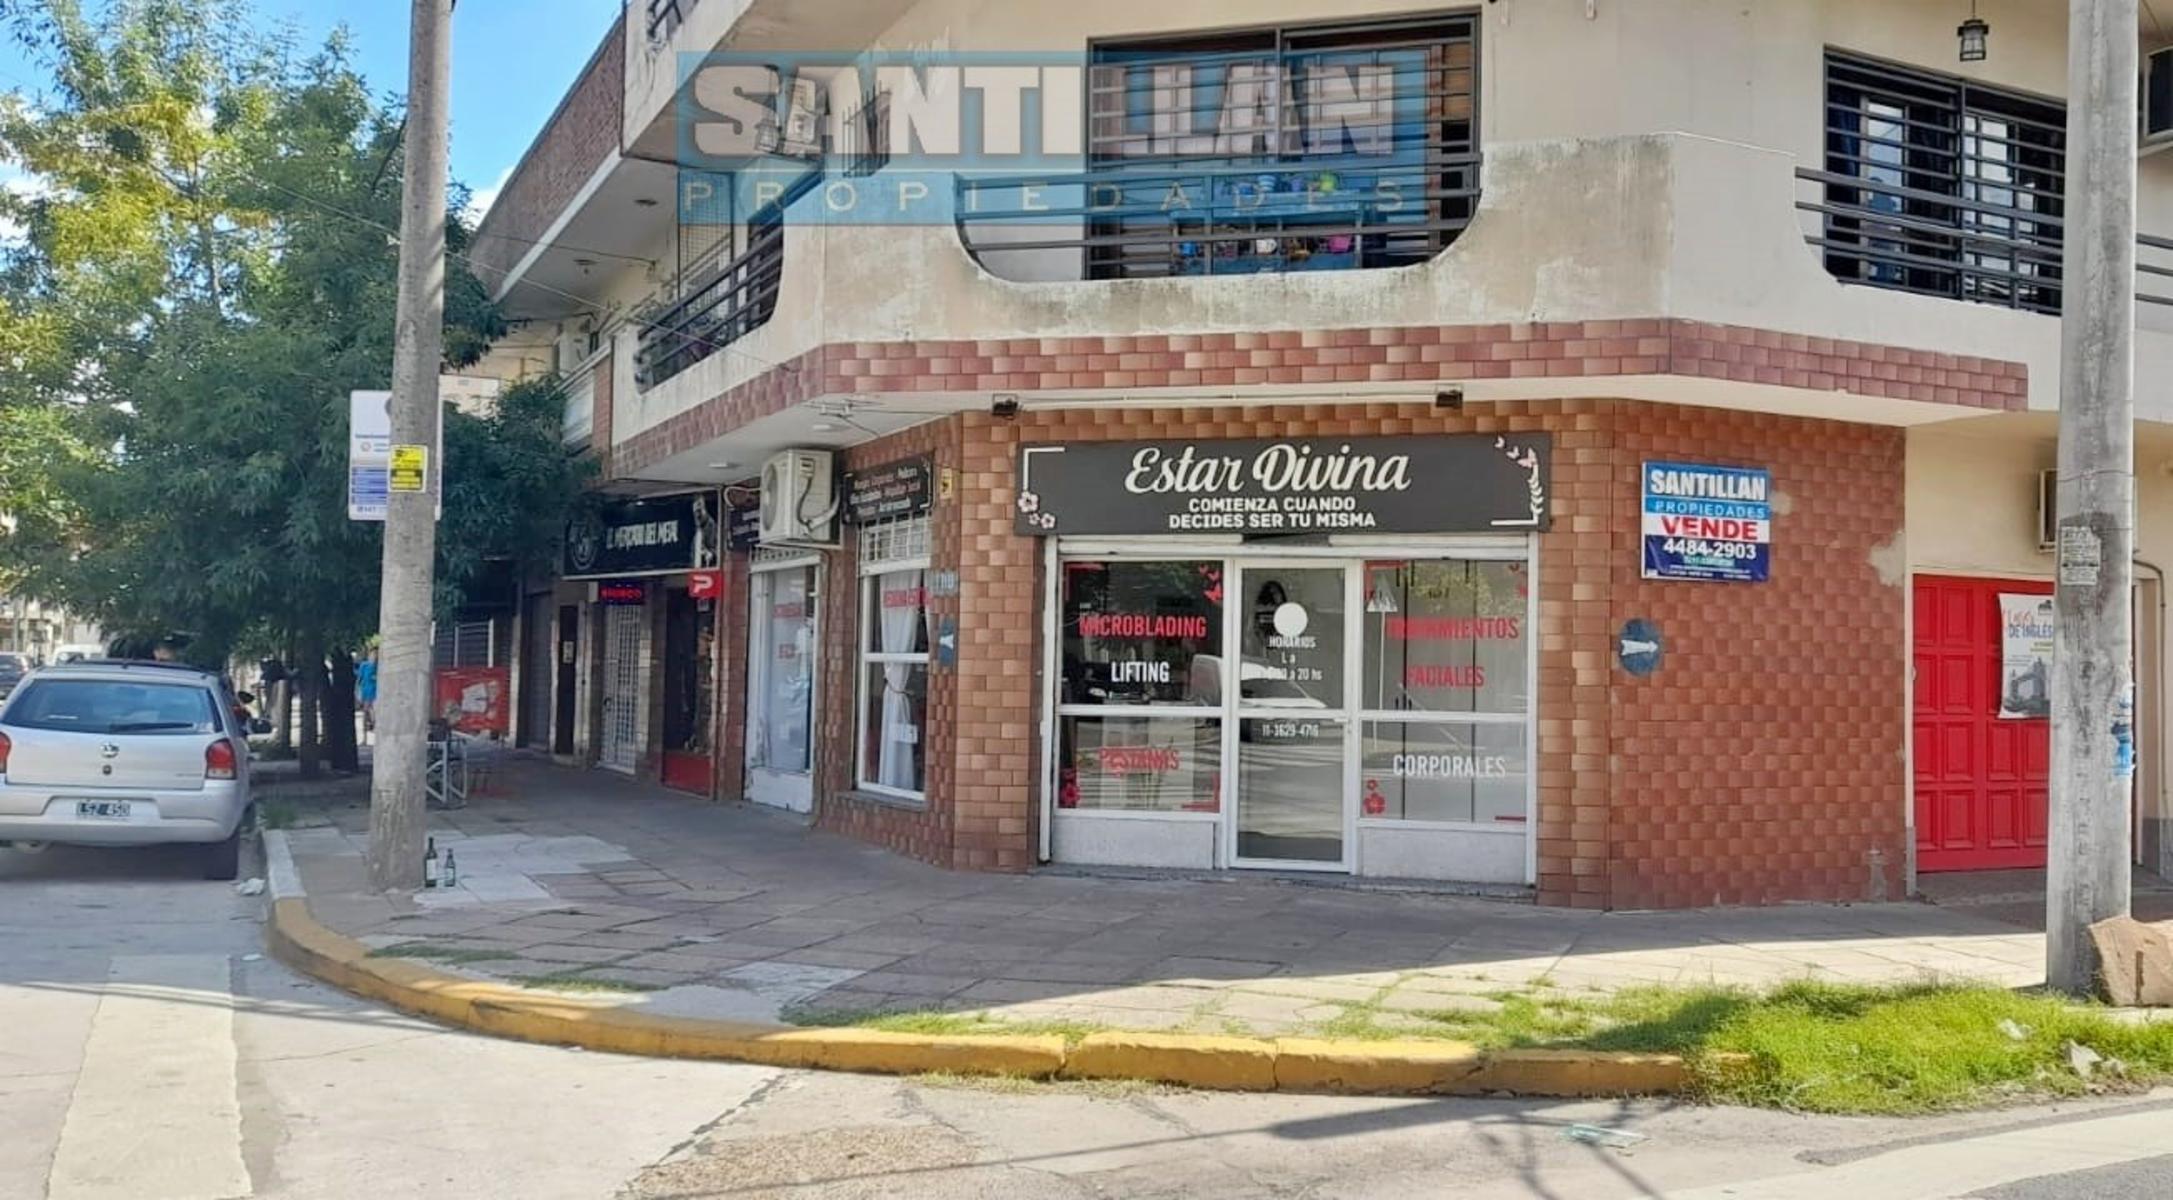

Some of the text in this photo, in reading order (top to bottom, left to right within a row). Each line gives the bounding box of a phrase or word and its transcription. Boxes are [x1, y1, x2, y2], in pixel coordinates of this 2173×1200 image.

[1124, 443, 1412, 494] Estar Divina
[1649, 468, 1767, 501] SANTILLAN
[1188, 496, 1356, 514] COMIENZA CUANDO
[1654, 500, 1767, 519] PROPIEDADES
[1169, 512, 1376, 529] DECIDES SER TU MISMA
[1661, 515, 1758, 540] VENDE
[1663, 538, 1757, 560] 4484-2903
[1079, 613, 1207, 638] MICROBLADING
[1111, 661, 1170, 683] LIFTING
[1392, 753, 1506, 779] CORPORALES
